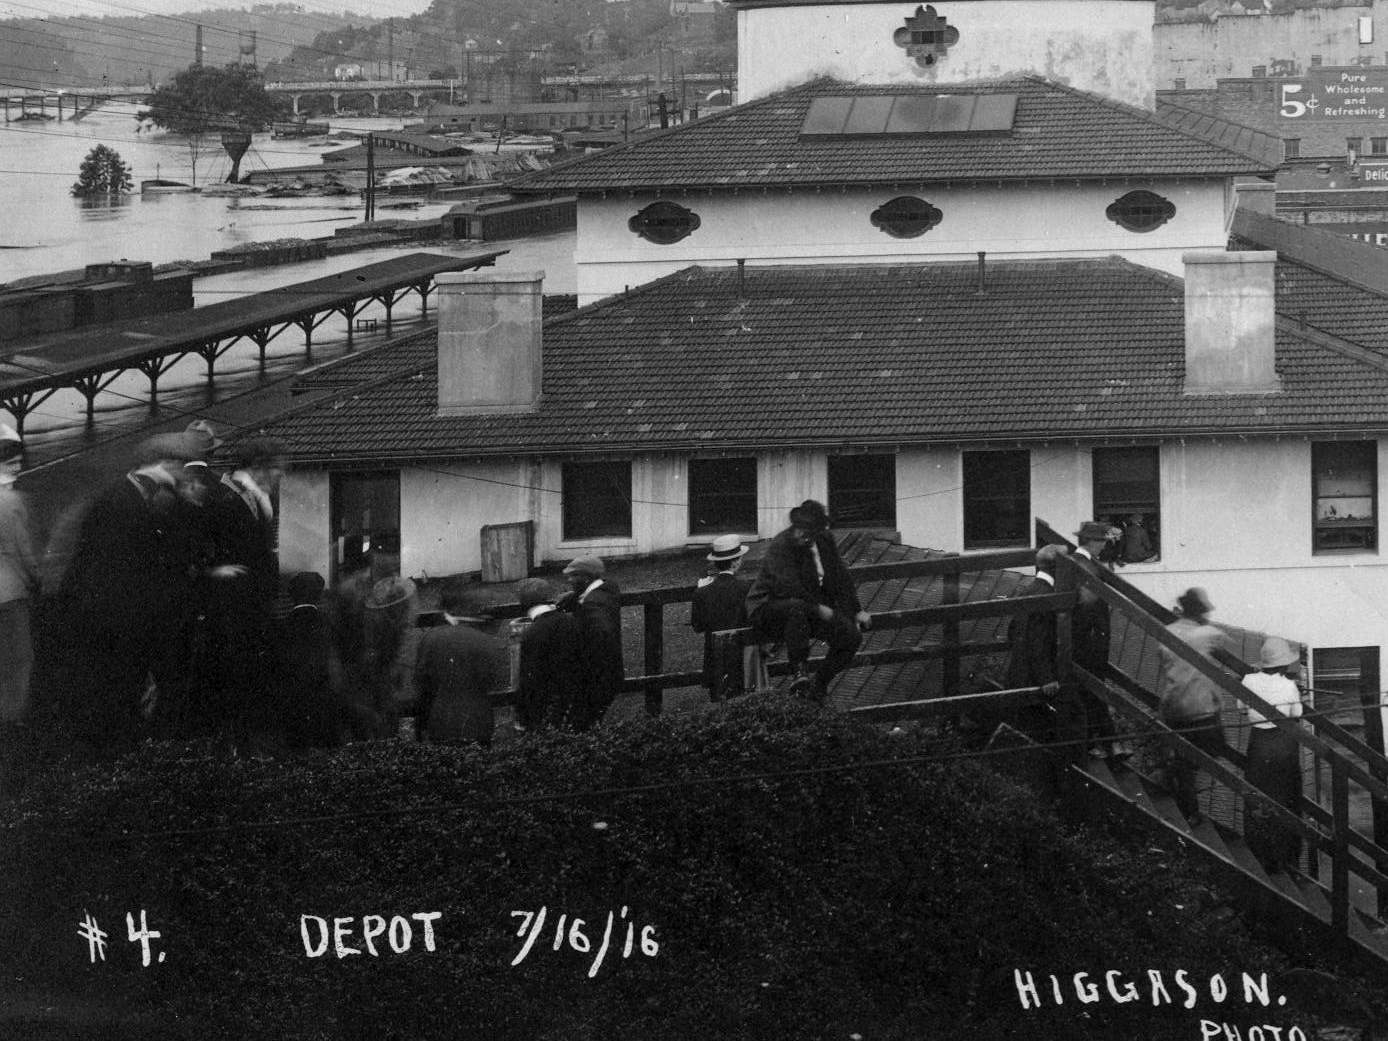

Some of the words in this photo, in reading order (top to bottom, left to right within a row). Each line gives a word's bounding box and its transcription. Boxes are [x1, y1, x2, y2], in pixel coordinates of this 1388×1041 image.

[1341, 73, 1366, 82] Pure
[1325, 85, 1384, 94] Wholesome
[1280, 84, 1320, 117] 5¢
[1343, 96, 1366, 105] and
[1325, 107, 1385, 119] Refreshing
